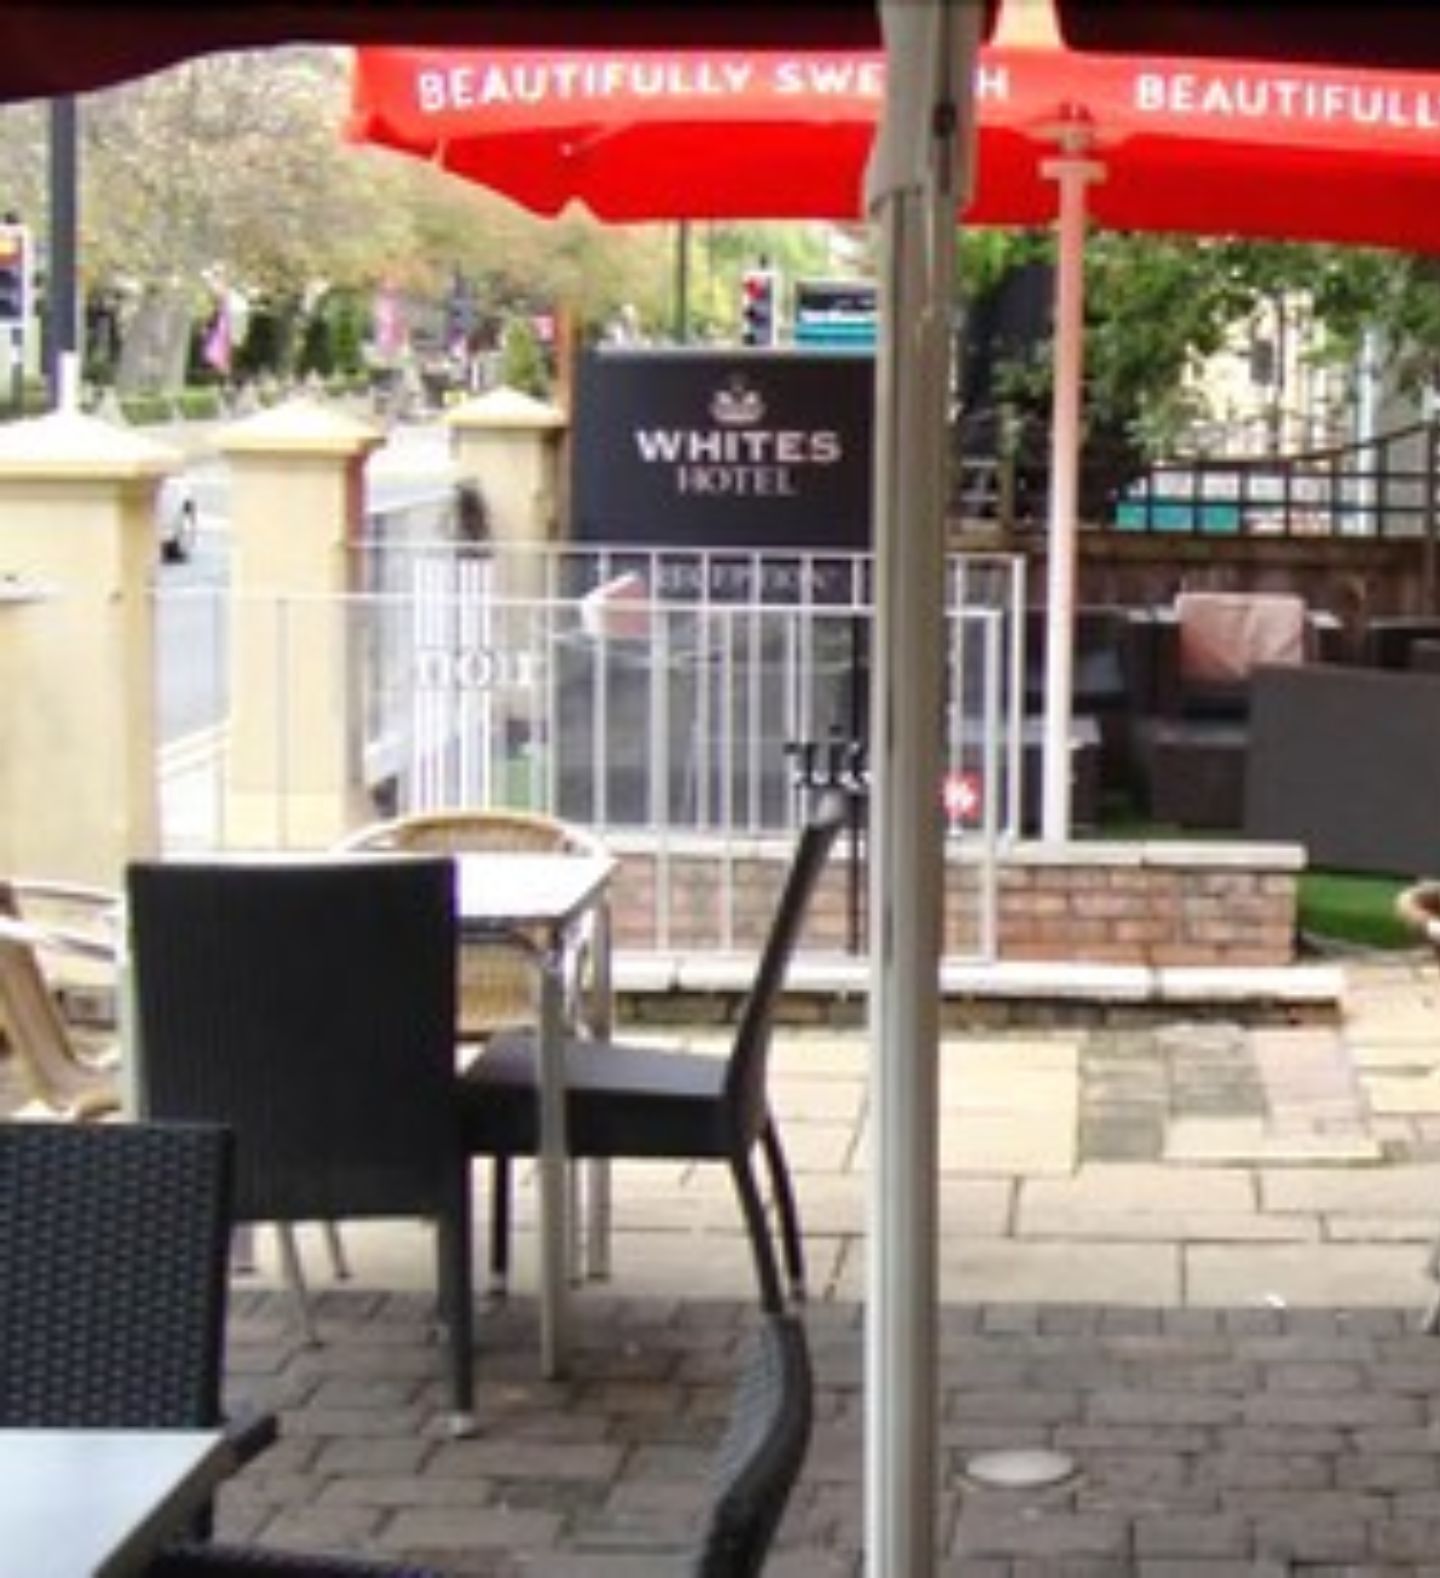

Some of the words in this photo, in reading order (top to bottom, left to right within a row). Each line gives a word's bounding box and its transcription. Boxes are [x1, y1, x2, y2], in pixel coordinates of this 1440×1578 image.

[417, 62, 752, 111] BEAUTIFULLY
[773, 61, 1010, 99] SWEH
[634, 429, 843, 464] WHITES
[676, 465, 799, 495] HOTEL
